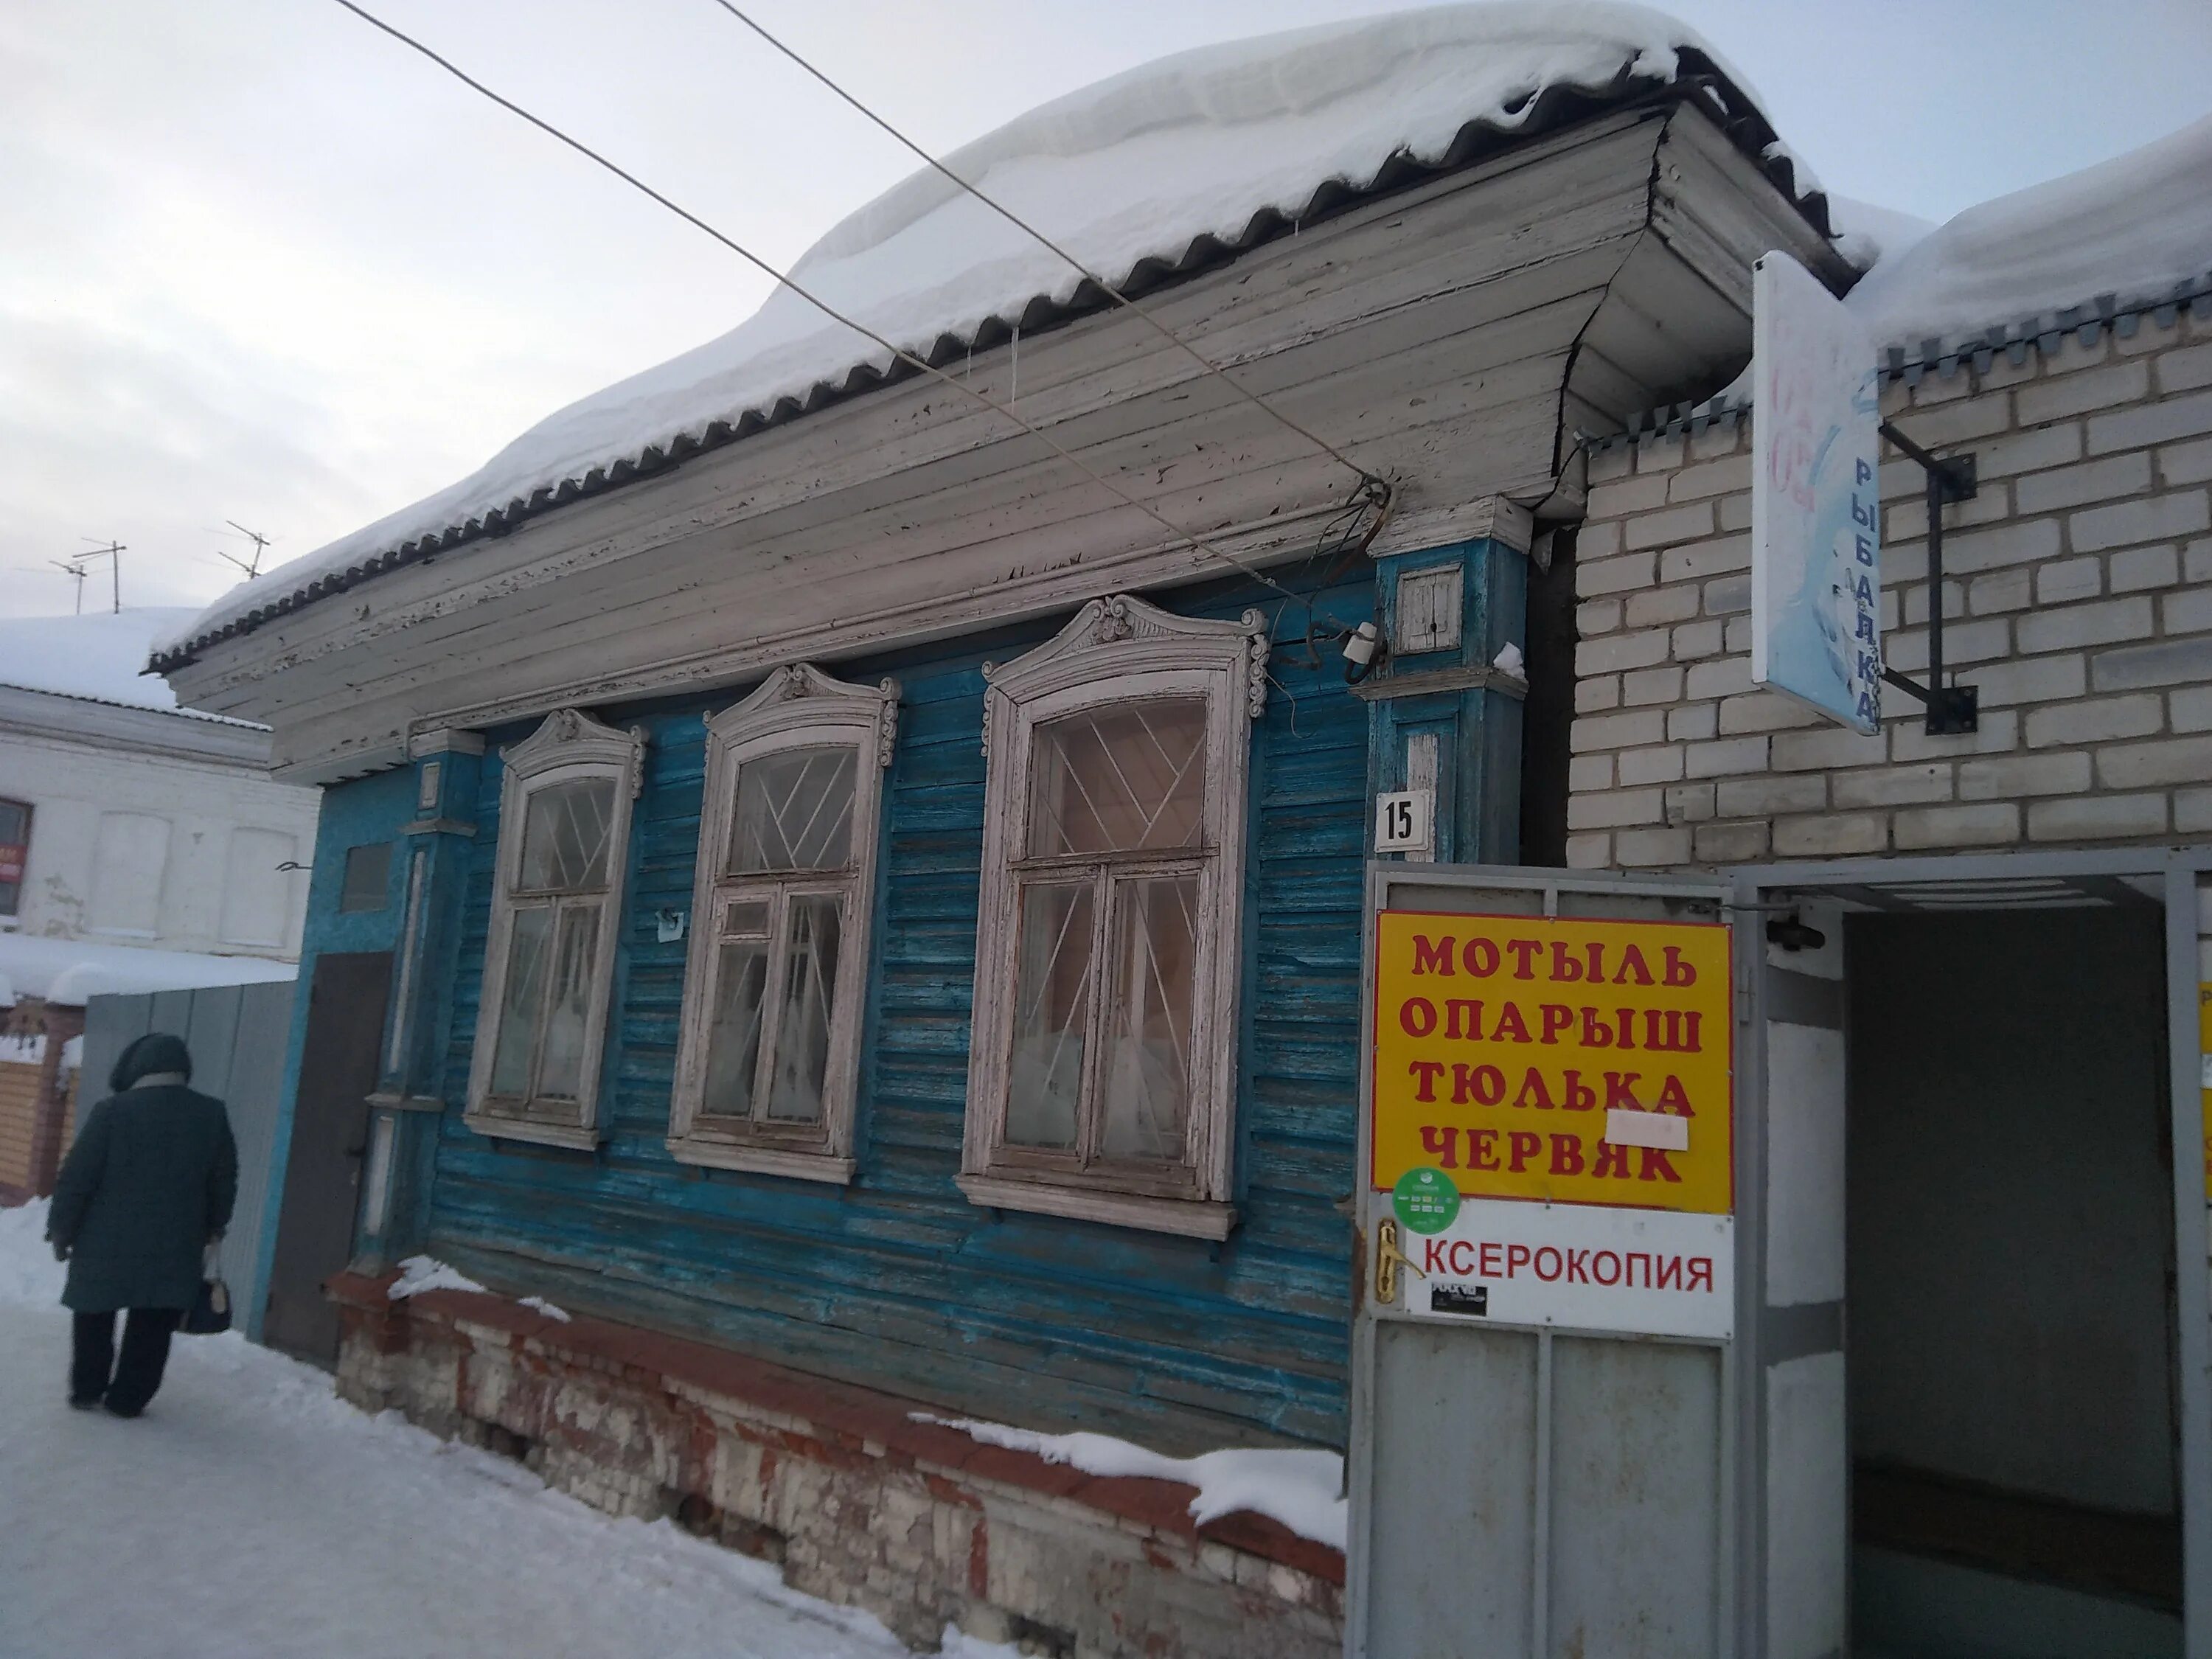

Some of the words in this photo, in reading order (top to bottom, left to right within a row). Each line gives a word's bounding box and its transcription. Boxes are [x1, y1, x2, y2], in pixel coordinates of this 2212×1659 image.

[1851, 456, 1876, 723] РЫБАЛКА
[1385, 800, 1412, 840] 15
[1411, 935, 1697, 987] МОТЫЛЬ
[1399, 997, 1703, 1053] ОПАРЫШ
[1408, 1061, 1696, 1117] ТЮЛЬКА
[1419, 1126, 1683, 1183] ЧЕРВЯК
[1424, 1238, 1714, 1293] КСЕРОКОПИЯ
